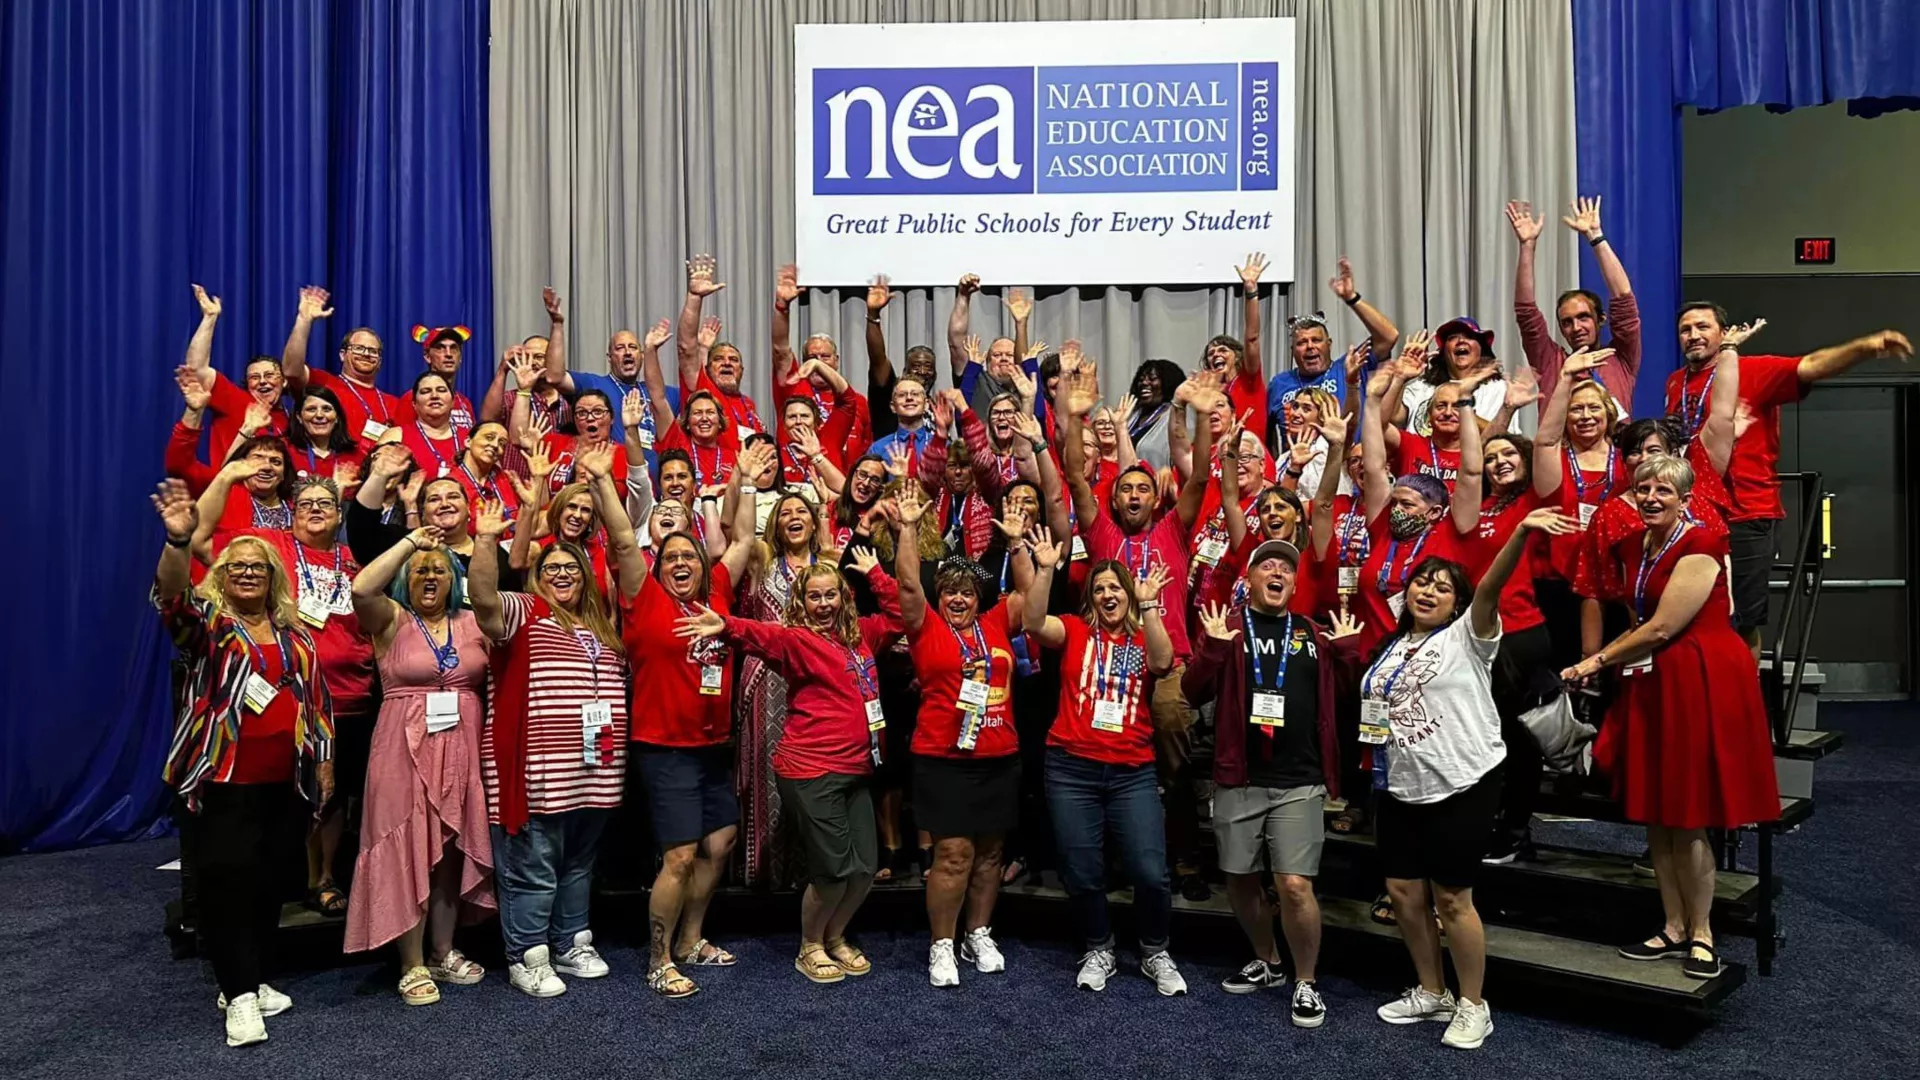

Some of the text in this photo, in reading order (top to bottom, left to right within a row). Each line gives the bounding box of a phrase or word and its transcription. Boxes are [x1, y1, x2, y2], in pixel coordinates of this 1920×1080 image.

[1046, 81, 1228, 110] NATIONAL
[824, 84, 1023, 180] nea
[1046, 118, 1229, 145] EDUCATION
[1246, 78, 1271, 177] nea.org
[1046, 152, 1228, 178] ASSOCIATION
[827, 209, 1273, 238] Great Public Schools for Every Student
[1804, 240, 1830, 260] EXIT
